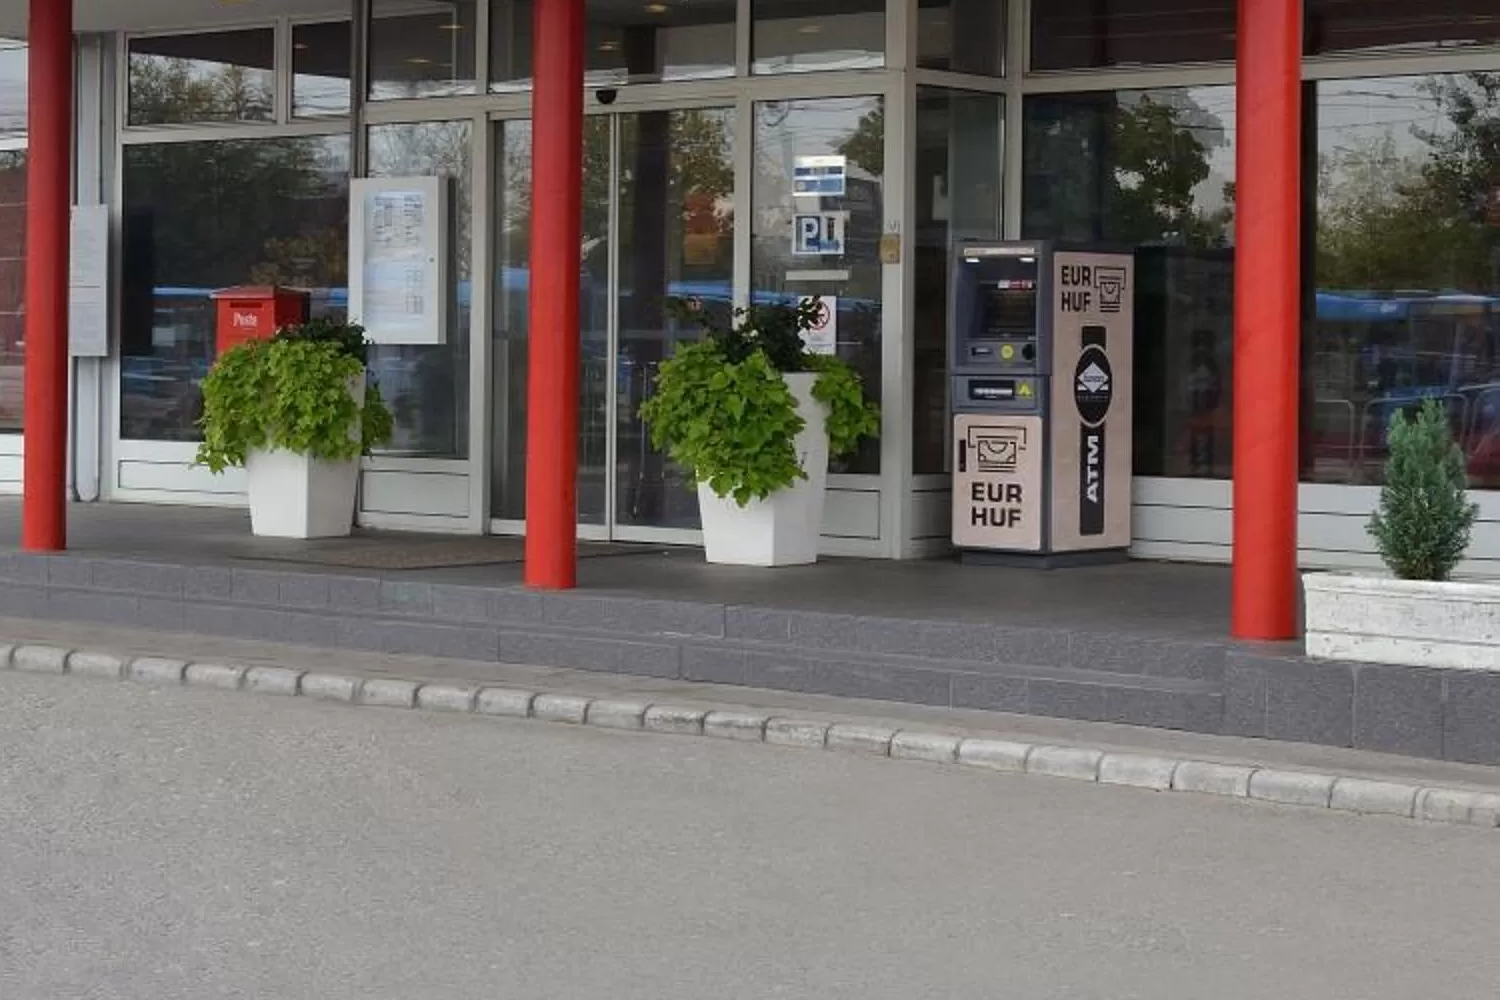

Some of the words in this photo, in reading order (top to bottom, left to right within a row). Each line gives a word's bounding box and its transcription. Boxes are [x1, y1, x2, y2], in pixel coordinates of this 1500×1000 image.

[1060, 265, 1091, 287] EUR
[1060, 291, 1091, 313] HUF
[1086, 435, 1099, 503] ATM
[971, 482, 1023, 503] EUR
[971, 507, 1021, 528] HUF
